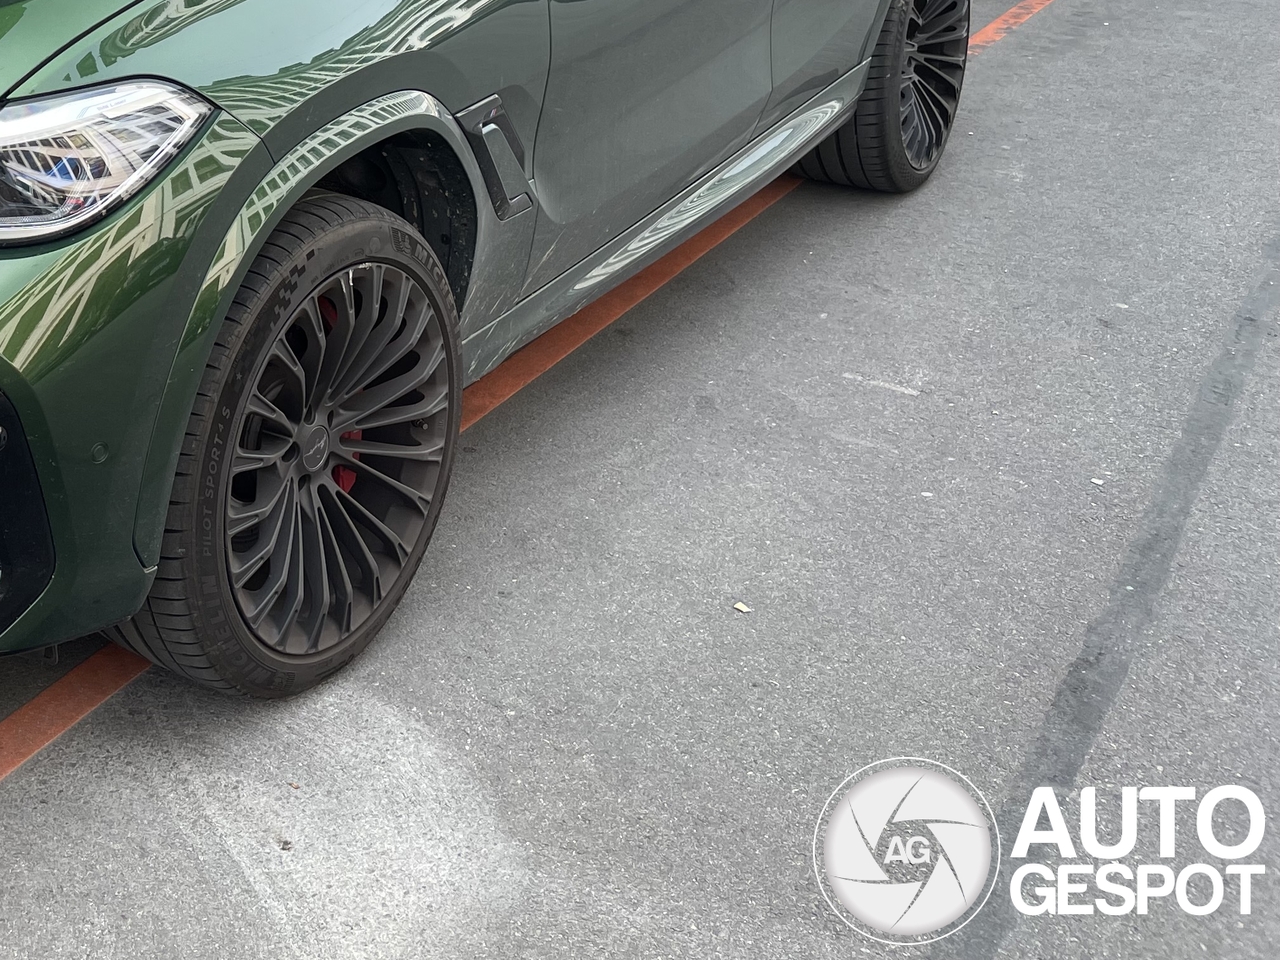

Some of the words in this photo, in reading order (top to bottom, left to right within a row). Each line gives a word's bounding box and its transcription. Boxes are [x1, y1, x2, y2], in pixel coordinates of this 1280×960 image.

[222, 404, 231, 420] S
[205, 433, 224, 499] SPORT
[202, 505, 213, 557] PILOT
[200, 574, 273, 685] MICHELIN
